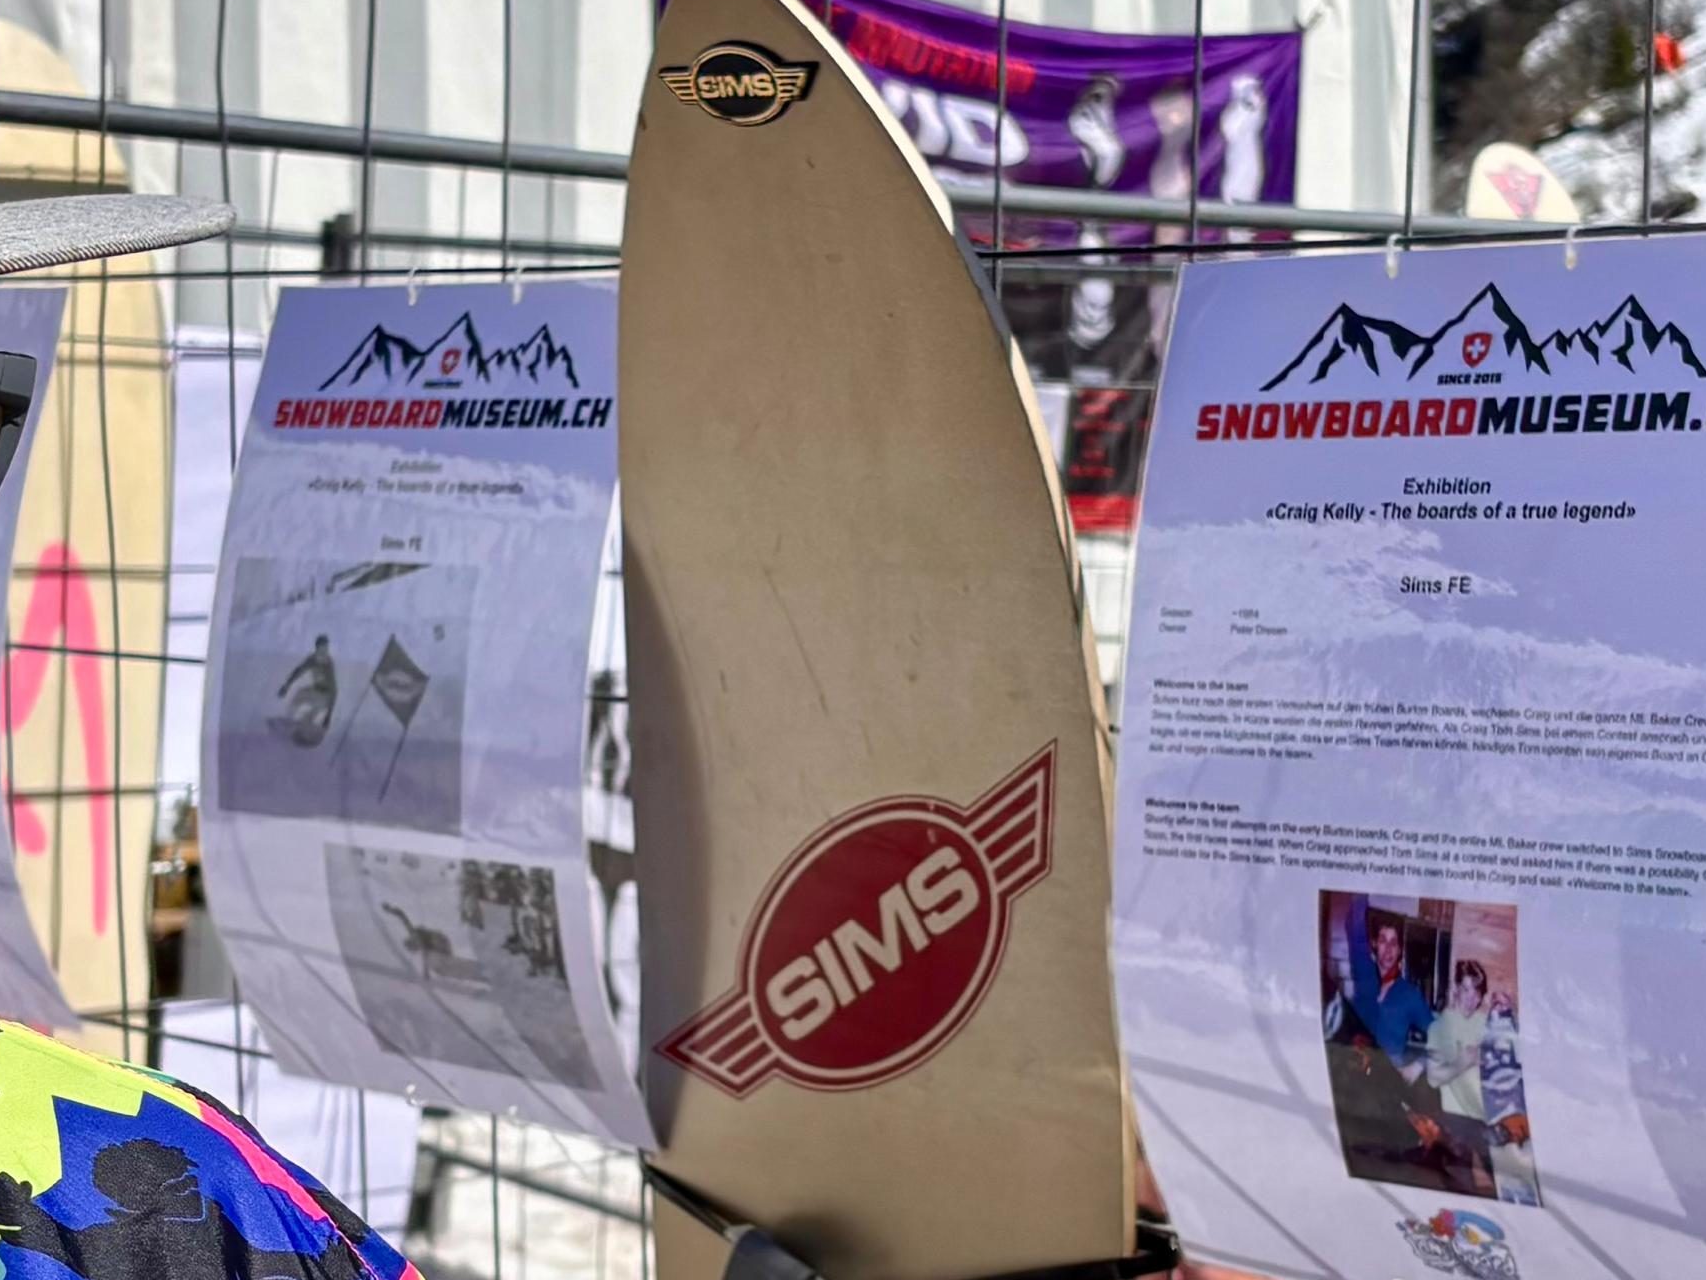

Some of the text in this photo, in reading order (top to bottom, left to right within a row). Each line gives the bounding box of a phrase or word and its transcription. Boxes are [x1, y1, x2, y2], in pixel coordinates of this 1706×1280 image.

[697, 72, 776, 99] SIMS
[275, 397, 613, 429] SNOWBOARDMUSEUM.CH
[1402, 477, 1492, 497] Exhibition
[1266, 503, 1318, 523] «Craig
[1322, 502, 1364, 522] Kelly
[1381, 501, 1412, 519] The
[1417, 501, 1477, 520] boards
[1483, 500, 1502, 519] of
[1505, 506, 1516, 519] a
[1522, 503, 1557, 519] true
[1563, 500, 1636, 523] legend»
[1400, 576, 1471, 595] Sims FE
[765, 845, 980, 1041] SIMS
